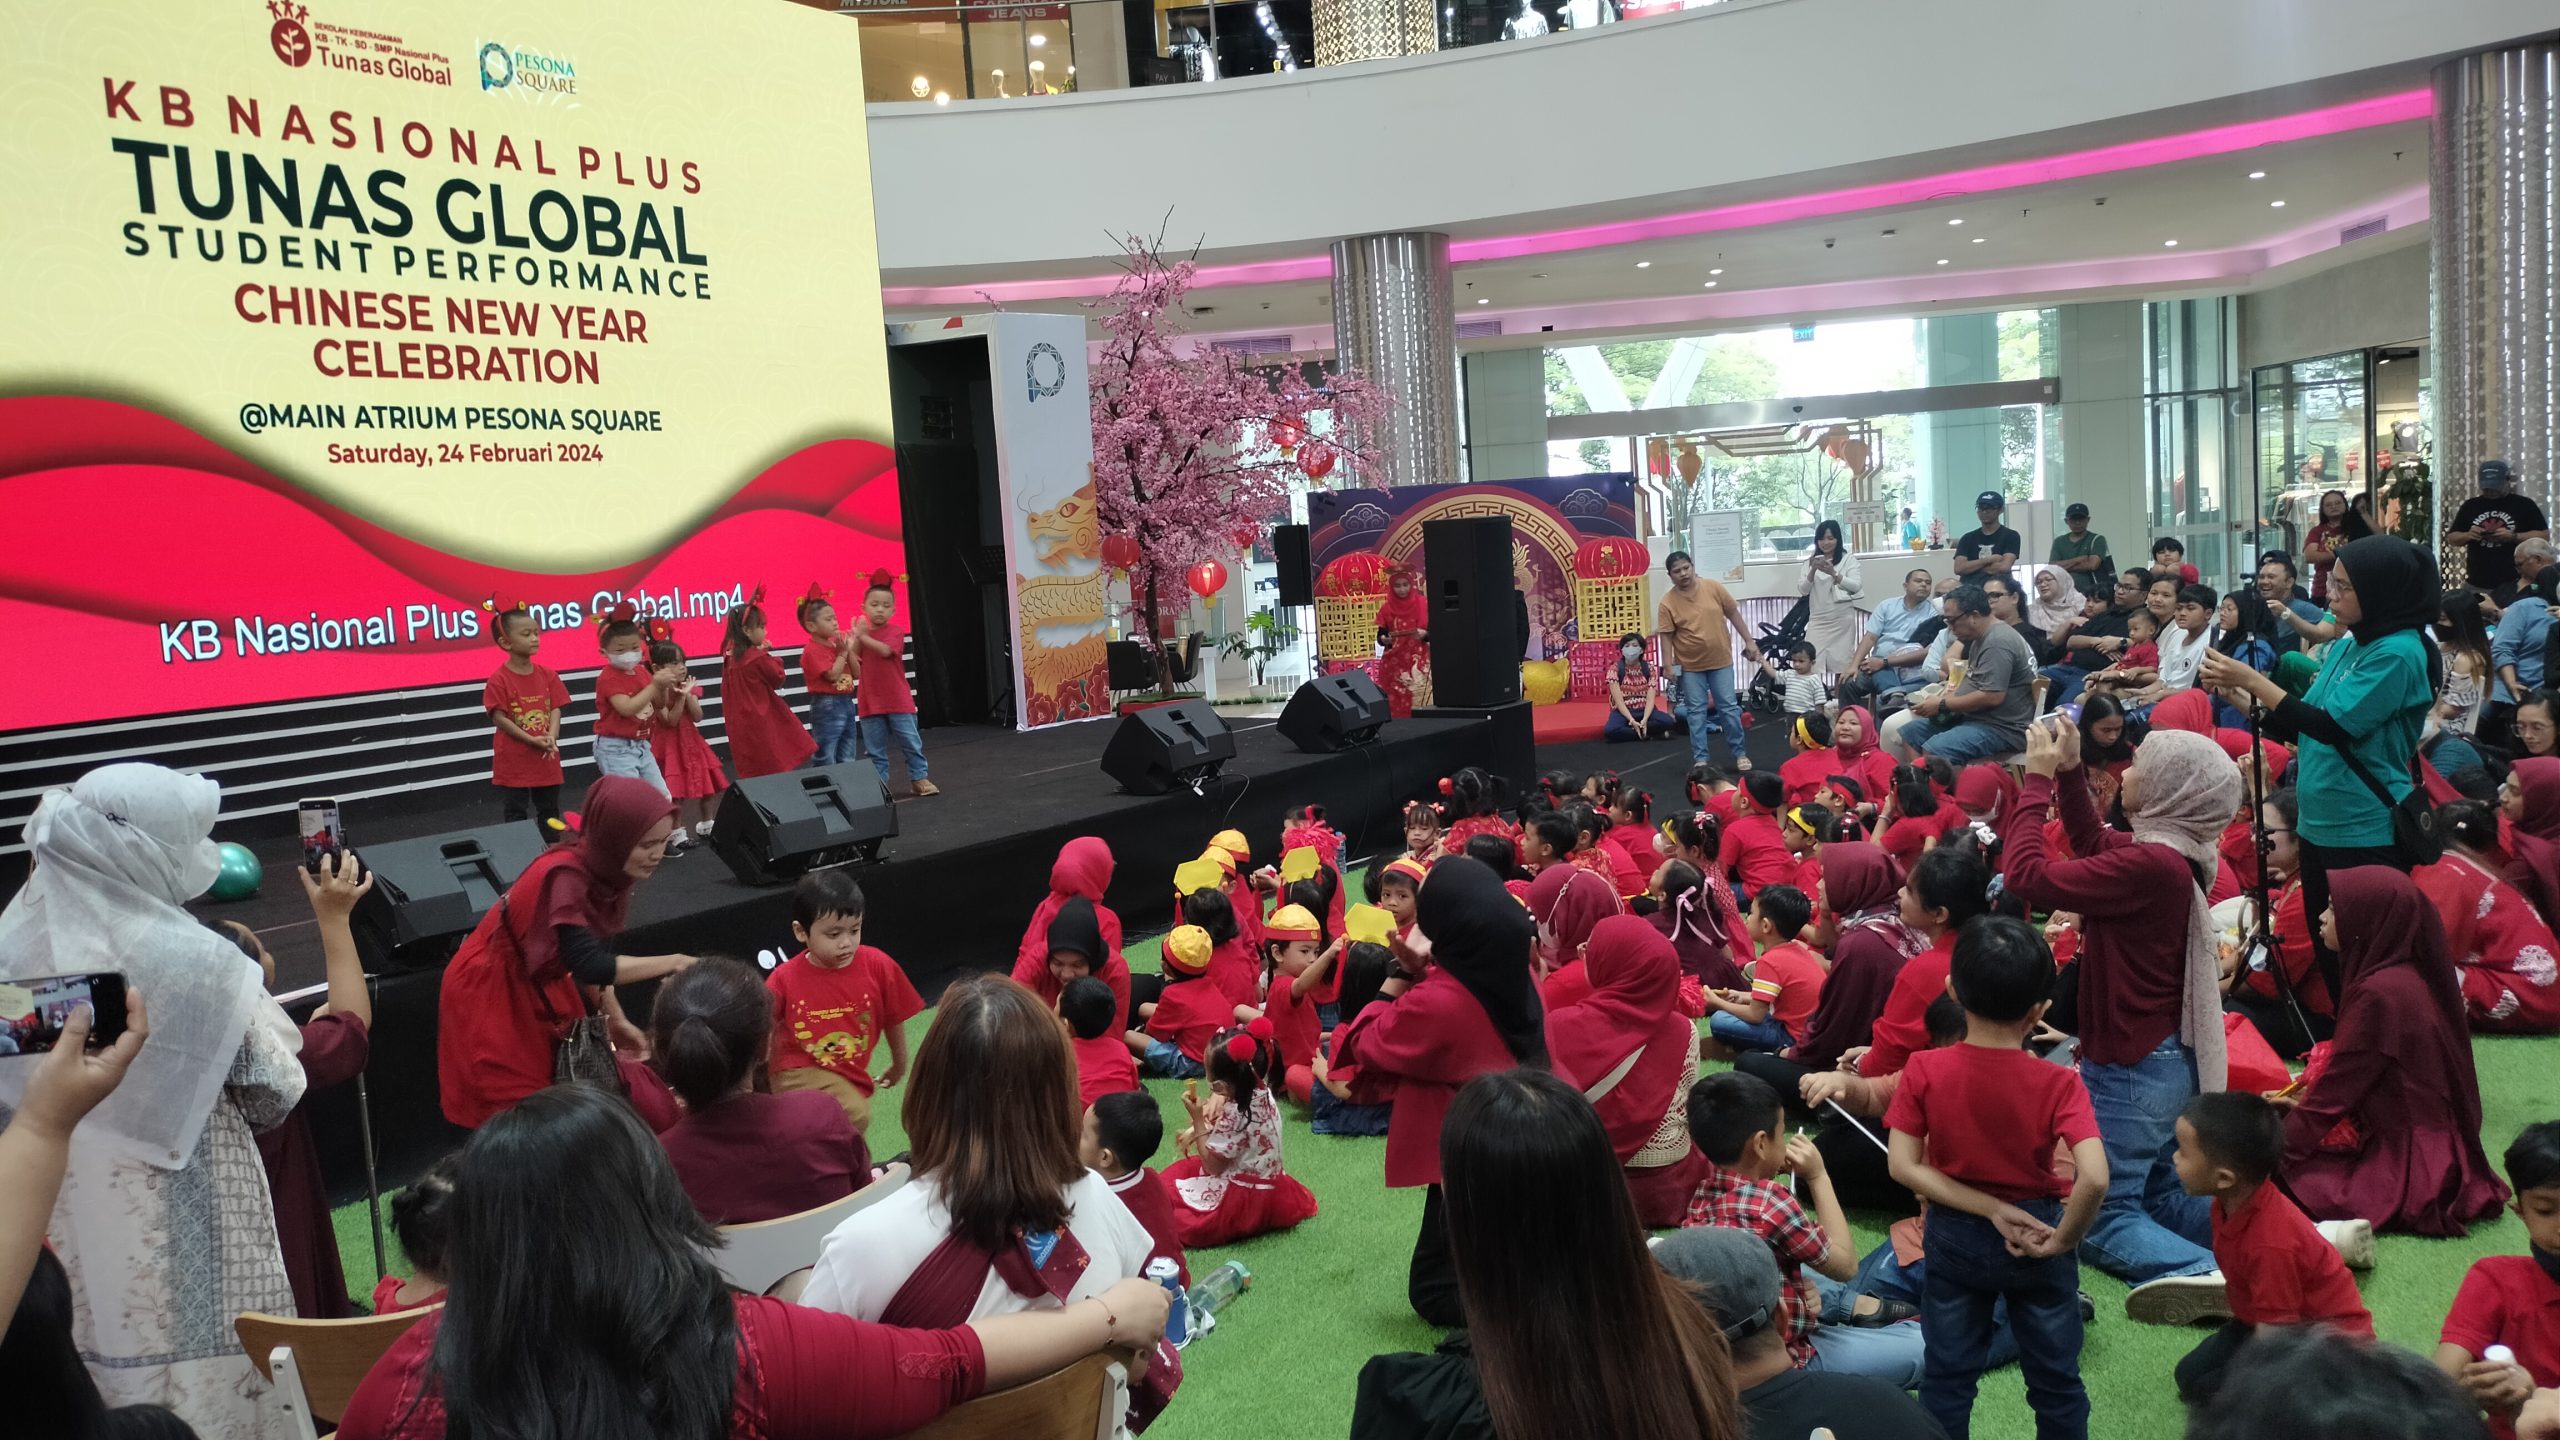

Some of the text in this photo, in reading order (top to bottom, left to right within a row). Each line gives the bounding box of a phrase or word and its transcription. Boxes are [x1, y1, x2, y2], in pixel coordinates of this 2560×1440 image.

[988, 8, 1047, 19] JEANS
[314, 22, 403, 44] SEKOLAH KEBERAGAMAN
[314, 33, 328, 43] KB
[335, 36, 347, 46] TK
[355, 40, 367, 50] SD
[374, 43, 392, 53] SMP
[395, 47, 430, 61] Nasional
[432, 53, 449, 64] Plus
[316, 45, 451, 86] Tunas Global
[515, 52, 575, 77] PESONA
[516, 70, 577, 95] SQUARE
[102, 77, 701, 194] KB NASIONAL PLUS
[112, 138, 709, 266] TUNAS GLOBAL
[123, 222, 711, 300] STUDENT PERFORMANCE
[234, 283, 648, 343] CHINESE NEW YEAR
[1794, 329, 1812, 340] EXIT
[313, 338, 600, 385] CELEBRATION
[240, 403, 662, 434] @MAIN ATRIUM PESONA SQUARE
[328, 443, 603, 467] Saturday, 24 Februari 2024
[2473, 511, 2490, 525] HOT
[159, 621, 222, 663] KB
[235, 610, 396, 656] Nasional
[407, 601, 479, 641] Plus
